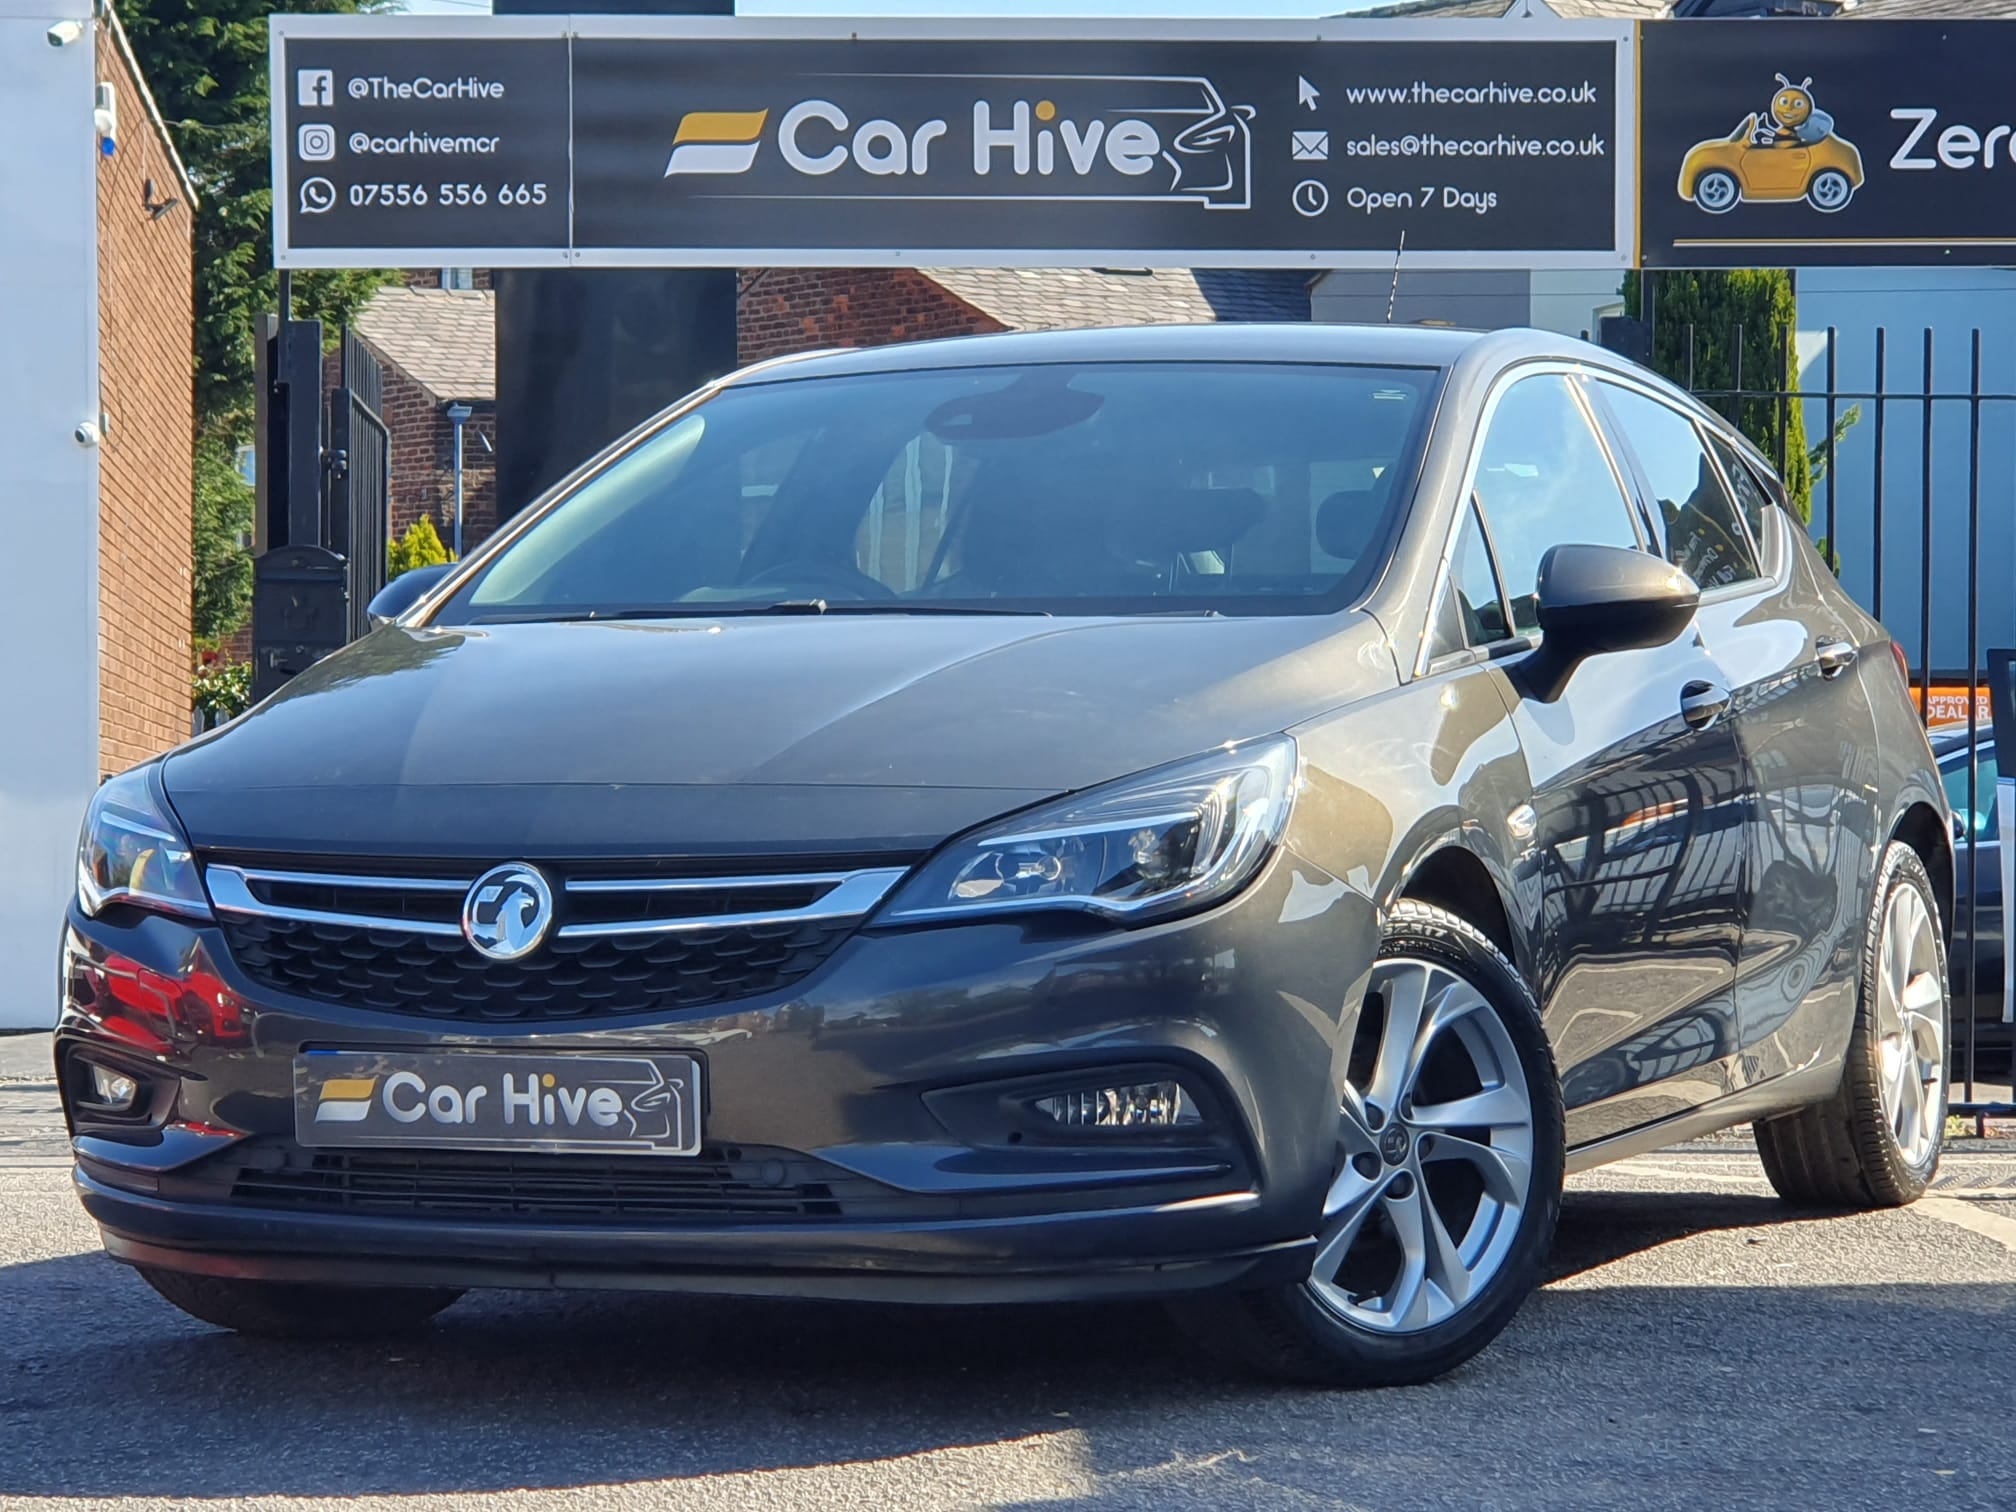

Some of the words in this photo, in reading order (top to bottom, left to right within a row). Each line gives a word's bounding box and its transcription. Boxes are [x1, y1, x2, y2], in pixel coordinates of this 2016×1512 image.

[347, 76, 505, 99] @TheCarHive
[1346, 80, 1597, 104] www.thecarhive.co.uk
[348, 131, 500, 154] @carhivemcr
[777, 99, 948, 176] Car
[973, 99, 1161, 176] Hive
[1346, 133, 1605, 156] sales@thecarhive.co.uk
[1889, 108, 2016, 169] Zer
[349, 183, 428, 206] 07556
[439, 183, 487, 205] 556
[498, 183, 547, 205] 665
[1346, 186, 1413, 213] Open
[1420, 187, 1435, 207] 7
[1443, 187, 1498, 214] Days
[1928, 705, 1989, 720] DEALR
[382, 1071, 488, 1124] Car
[502, 1072, 624, 1127] Hive
